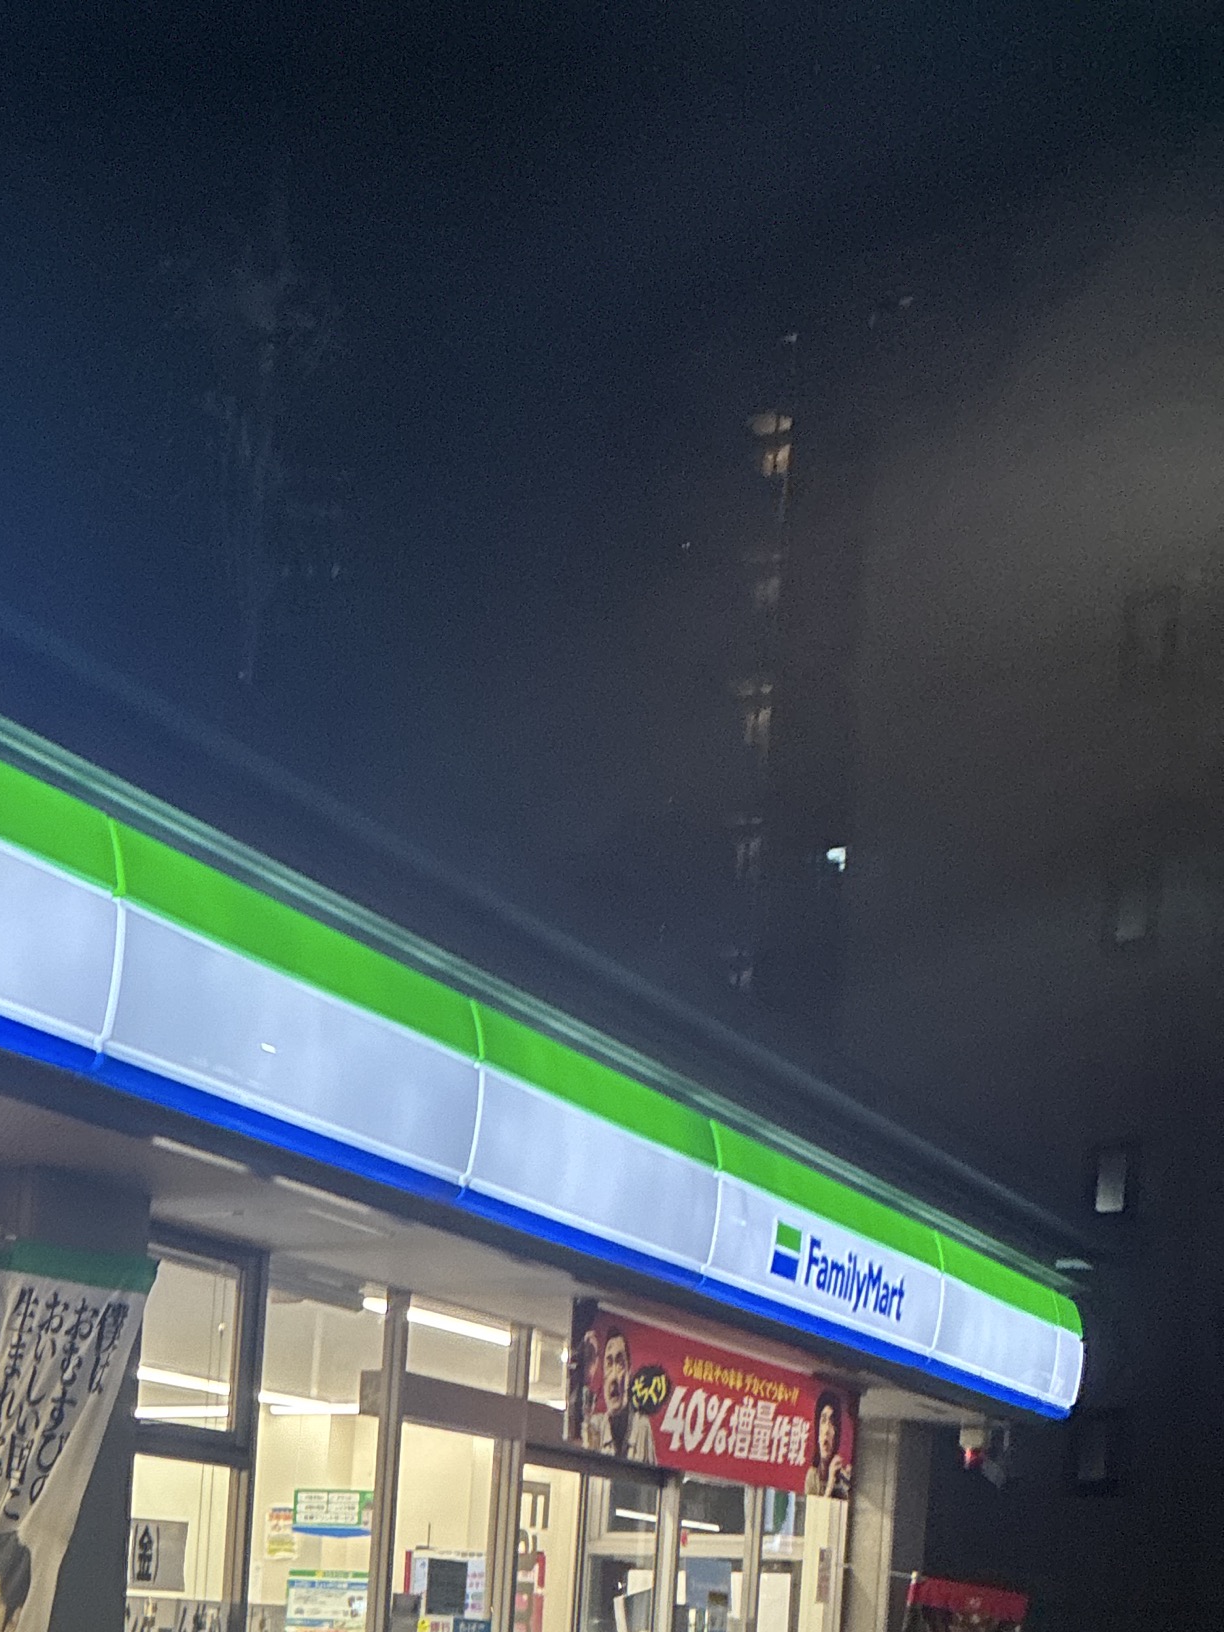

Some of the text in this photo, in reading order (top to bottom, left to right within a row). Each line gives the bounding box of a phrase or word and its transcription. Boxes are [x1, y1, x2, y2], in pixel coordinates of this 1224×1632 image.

[804, 1235, 904, 1321] FamilyMart
[660, 1386, 810, 1467] 40%増量作戦
